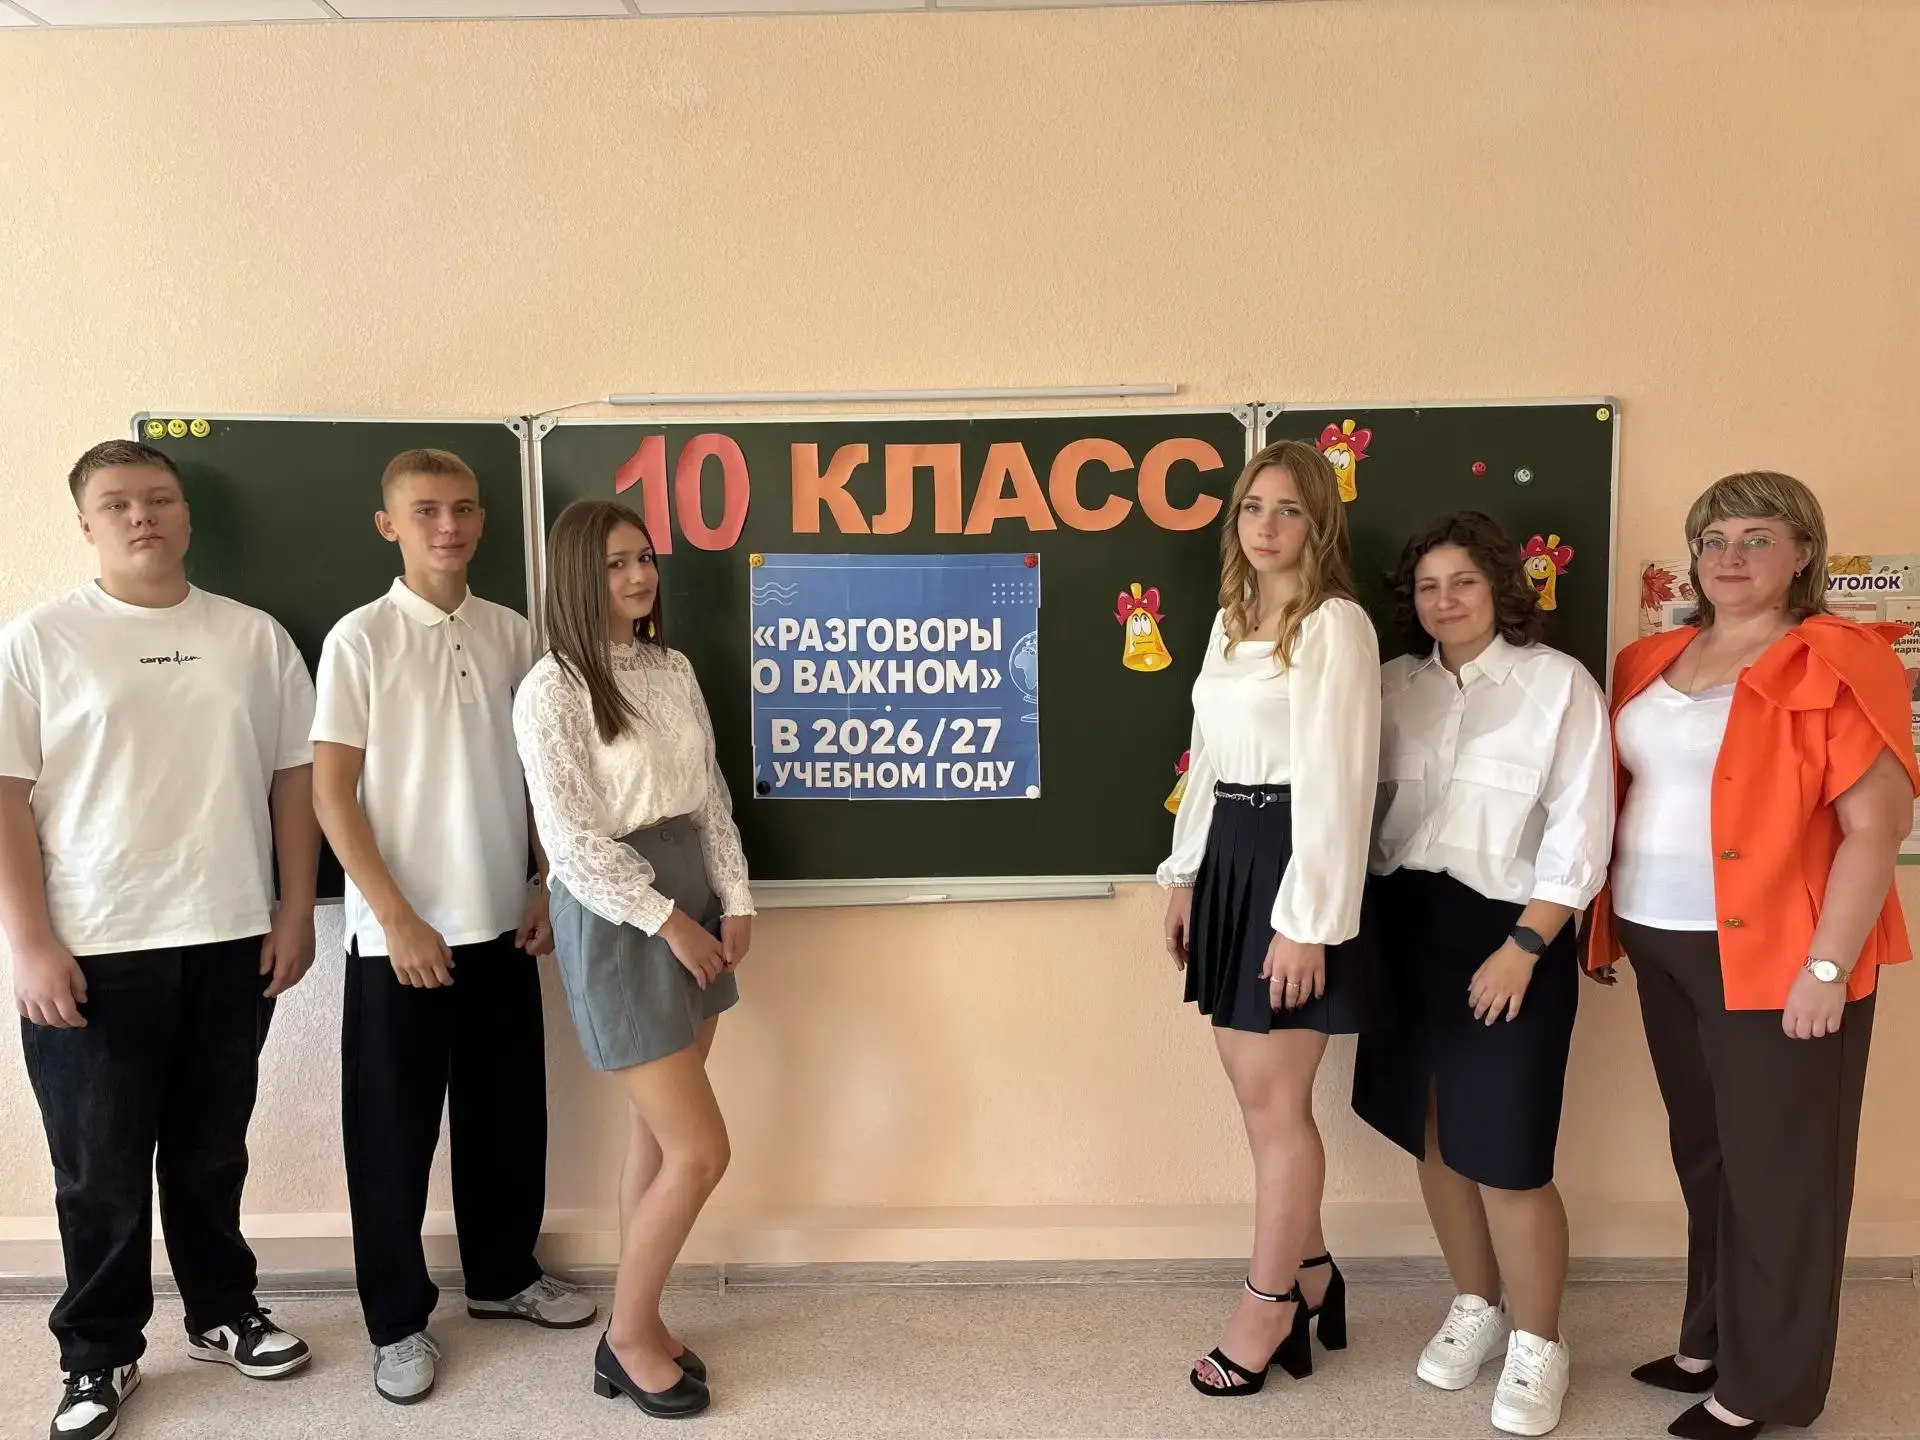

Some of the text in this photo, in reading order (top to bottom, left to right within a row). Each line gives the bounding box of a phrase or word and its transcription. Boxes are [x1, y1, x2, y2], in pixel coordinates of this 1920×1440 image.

[615, 433, 1224, 554] 10 КЛАСС
[1827, 576, 1901, 590] УГОЛОК
[754, 617, 1002, 652] «РАЗГОВОРЫ
[1894, 638, 1920, 647] данн
[140, 650, 202, 666] carpe diem
[753, 658, 1002, 694] О ВАЖНОМ»
[771, 717, 1002, 756] В 2026/27
[772, 760, 1015, 791] УЧЕБНОМ ГОДУ
